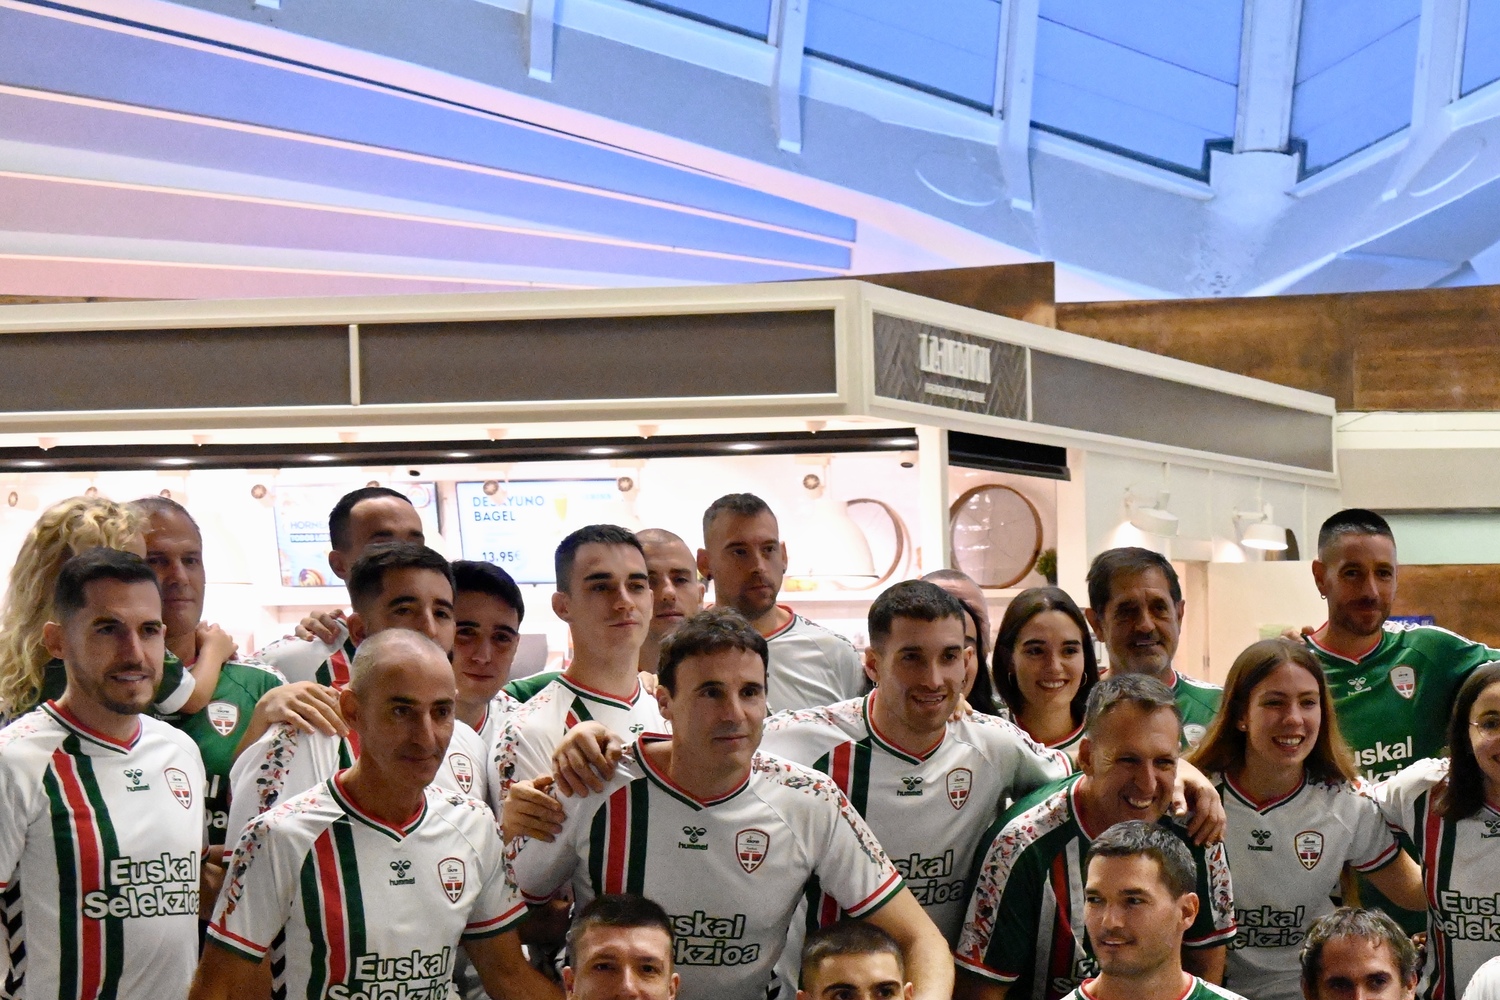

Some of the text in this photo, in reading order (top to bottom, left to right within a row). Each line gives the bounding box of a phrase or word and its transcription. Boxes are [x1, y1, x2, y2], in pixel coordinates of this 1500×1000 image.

[473, 496, 545, 507] DEYUNO
[474, 511, 516, 521] BAGEL
[1355, 736, 1412, 766] skal
[678, 842, 709, 850] hummel
[109, 851, 196, 886] Euskal
[896, 849, 954, 880] skal
[389, 877, 415, 886] hummel
[672, 910, 746, 939] skal
[1236, 905, 1305, 928] uskal
[354, 946, 451, 981] Euskal
[673, 938, 760, 966] kzioa
